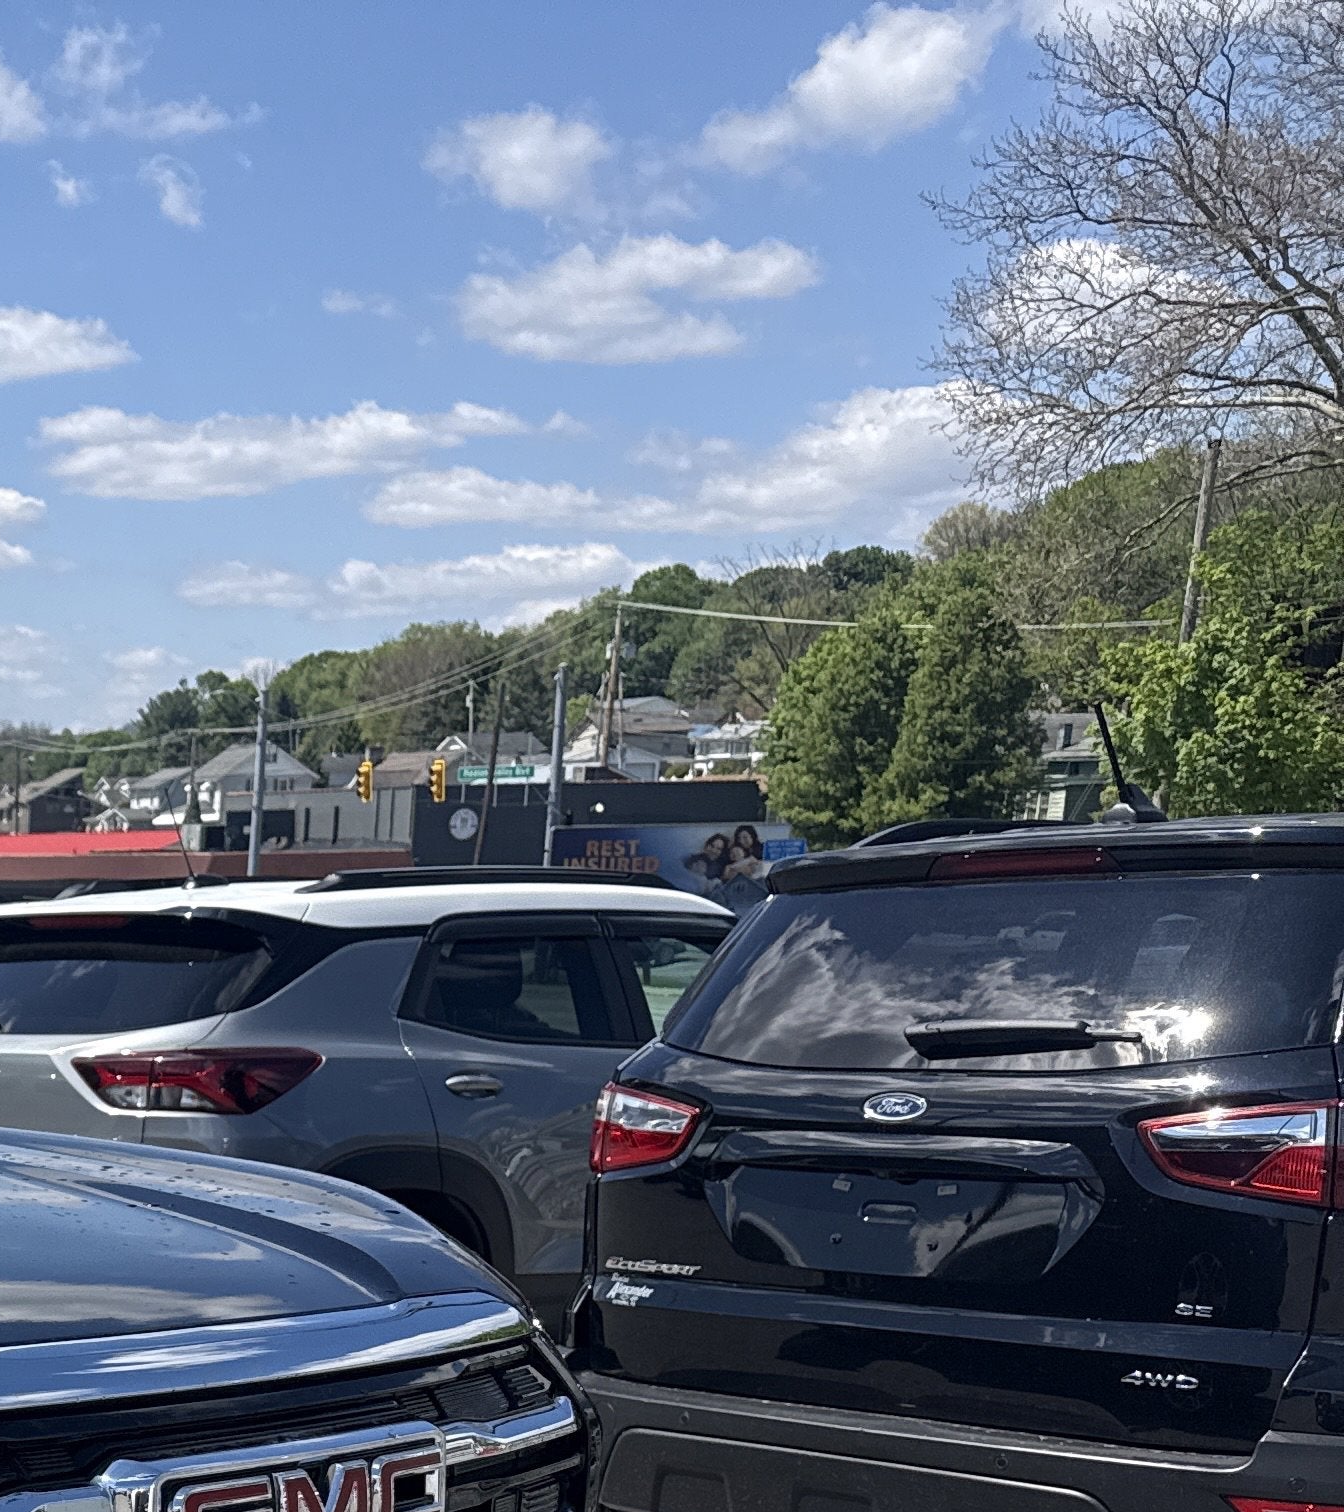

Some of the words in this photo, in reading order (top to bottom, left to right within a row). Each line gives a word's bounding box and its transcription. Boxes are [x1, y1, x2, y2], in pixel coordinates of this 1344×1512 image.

[586, 840, 639, 857] REST
[563, 856, 660, 873] INSURED
[877, 1097, 914, 1114] Ford
[1175, 1303, 1213, 1317] SE
[1120, 1370, 1199, 1389] 4WD
